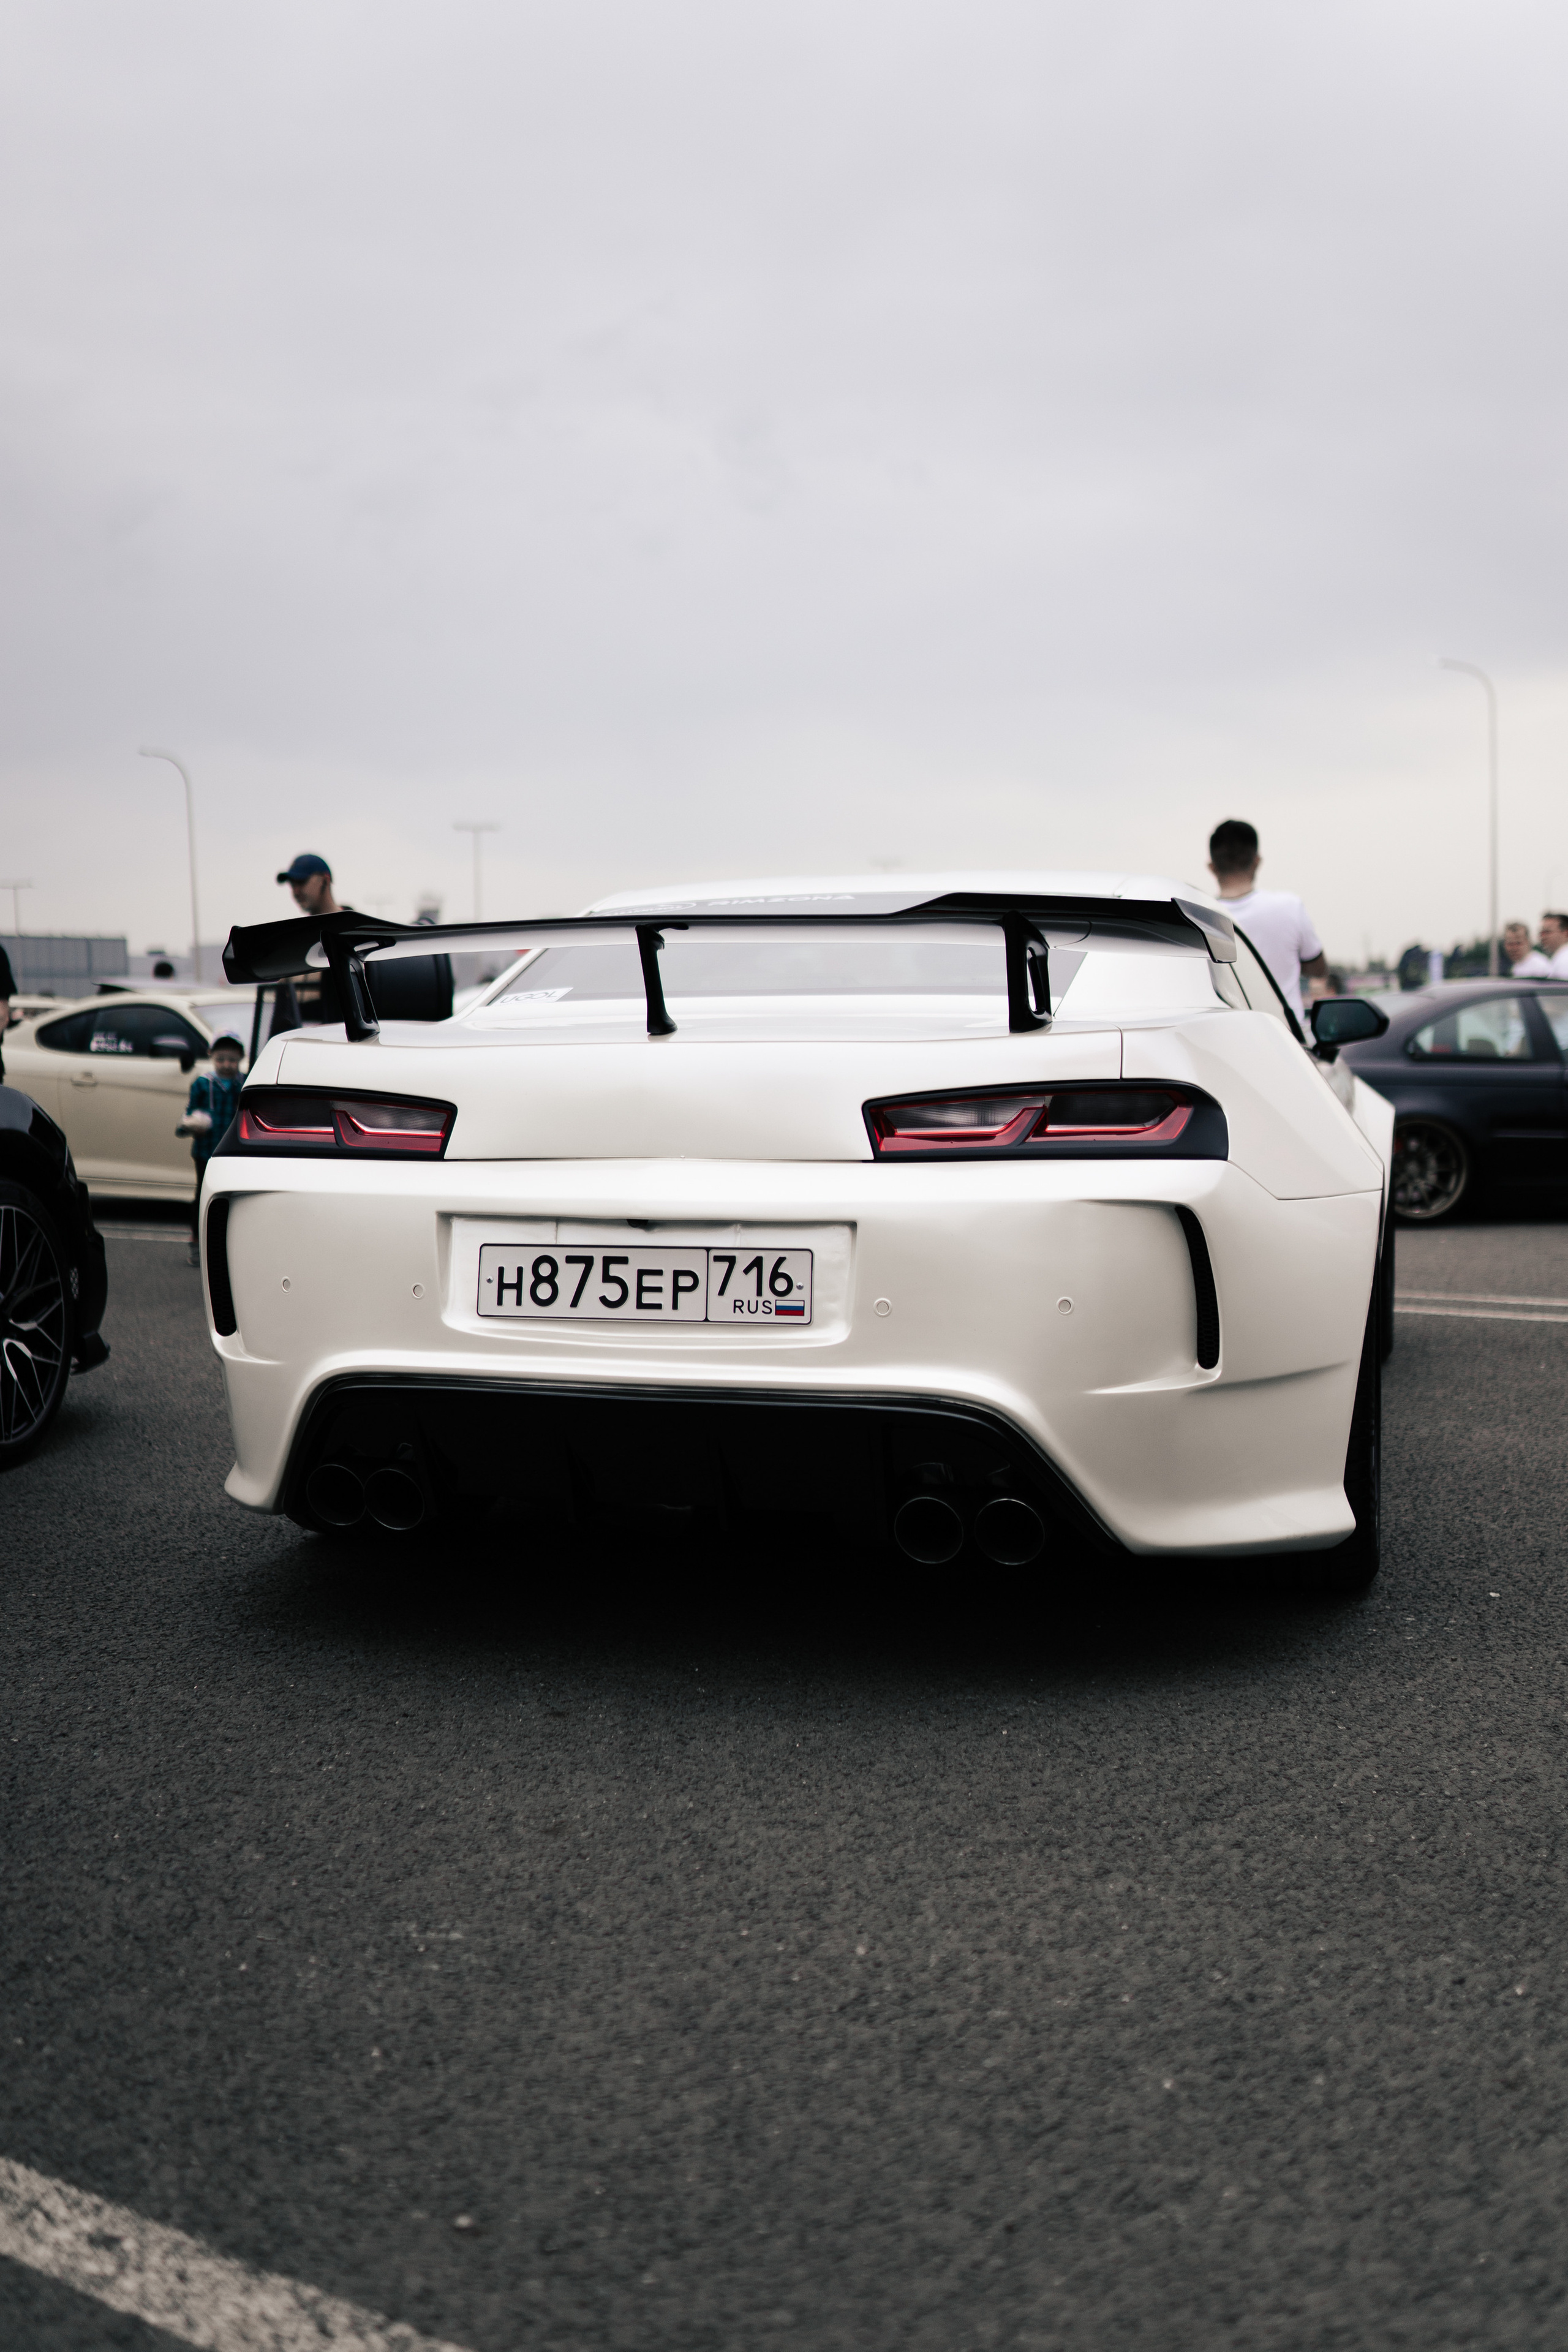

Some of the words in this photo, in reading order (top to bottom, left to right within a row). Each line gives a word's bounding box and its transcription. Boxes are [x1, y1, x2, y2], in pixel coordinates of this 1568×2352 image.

[708, 895, 855, 907] RIMZONA
[712, 1255, 794, 1298] 716
[733, 1299, 772, 1315] RUS
